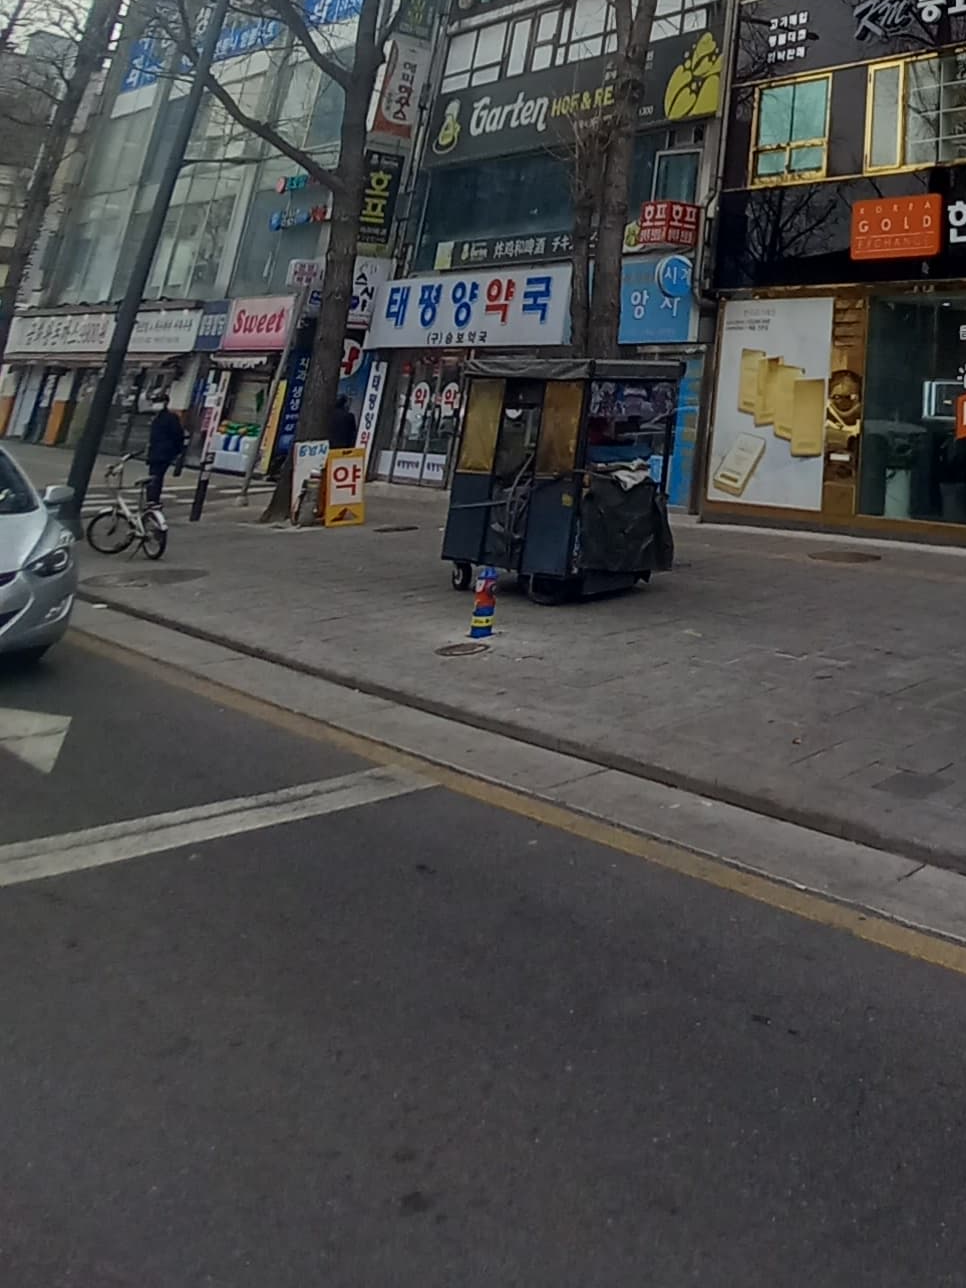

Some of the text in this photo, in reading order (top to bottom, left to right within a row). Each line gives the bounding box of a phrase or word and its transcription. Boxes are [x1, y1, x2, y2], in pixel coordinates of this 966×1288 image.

[469, 91, 550, 137] Garten
[360, 170, 392, 224] 호프
[642, 204, 667, 227] 호프
[670, 205, 697, 229] 호프
[859, 215, 932, 233] GOLD
[385, 276, 553, 329] 태평양약국
[232, 308, 286, 335] Sweet
[333, 464, 362, 496] 약
